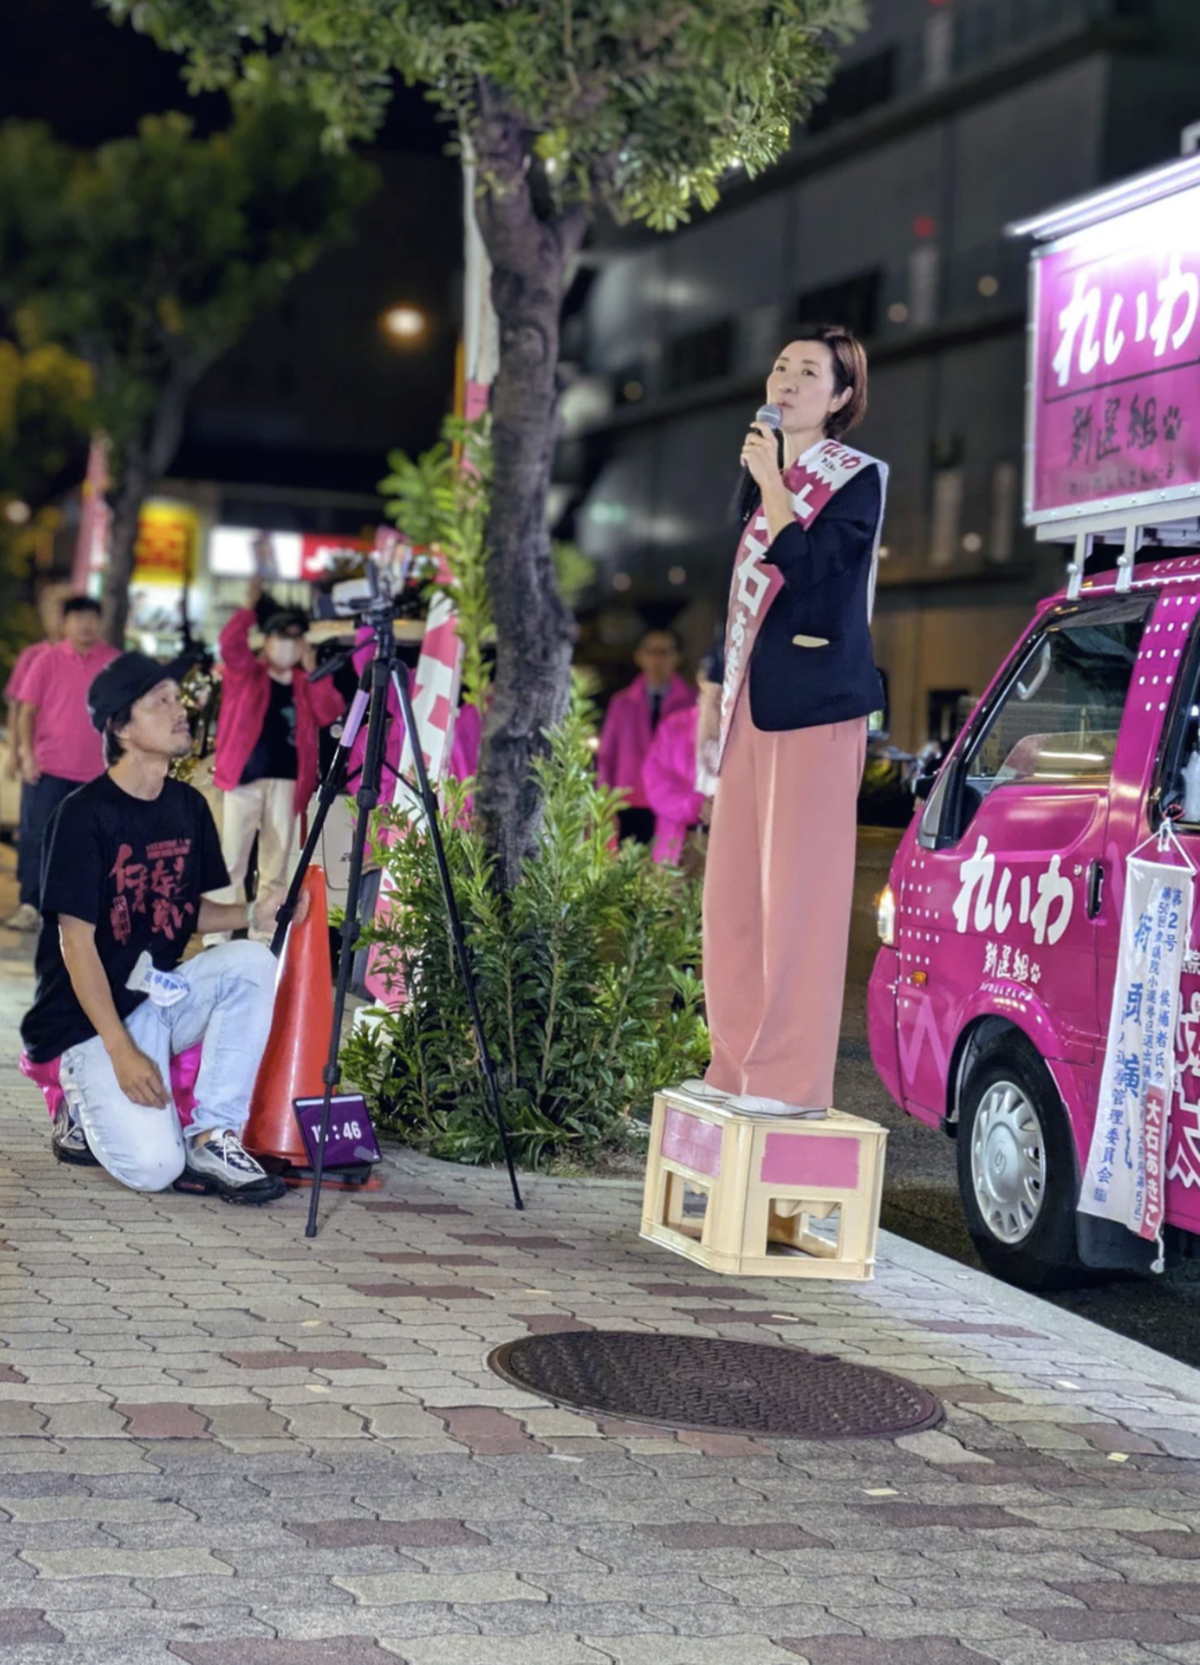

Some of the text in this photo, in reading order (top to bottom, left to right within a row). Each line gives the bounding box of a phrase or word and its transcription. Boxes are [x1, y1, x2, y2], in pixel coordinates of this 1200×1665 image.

[1051, 252, 1199, 388] れいわ
[1068, 393, 1158, 467] 新選組
[952, 835, 1074, 945] れいわ
[1164, 887, 1183, 952] 第2号
[982, 941, 1029, 982] 新選組
[1144, 1099, 1161, 1228] 大石あきこ
